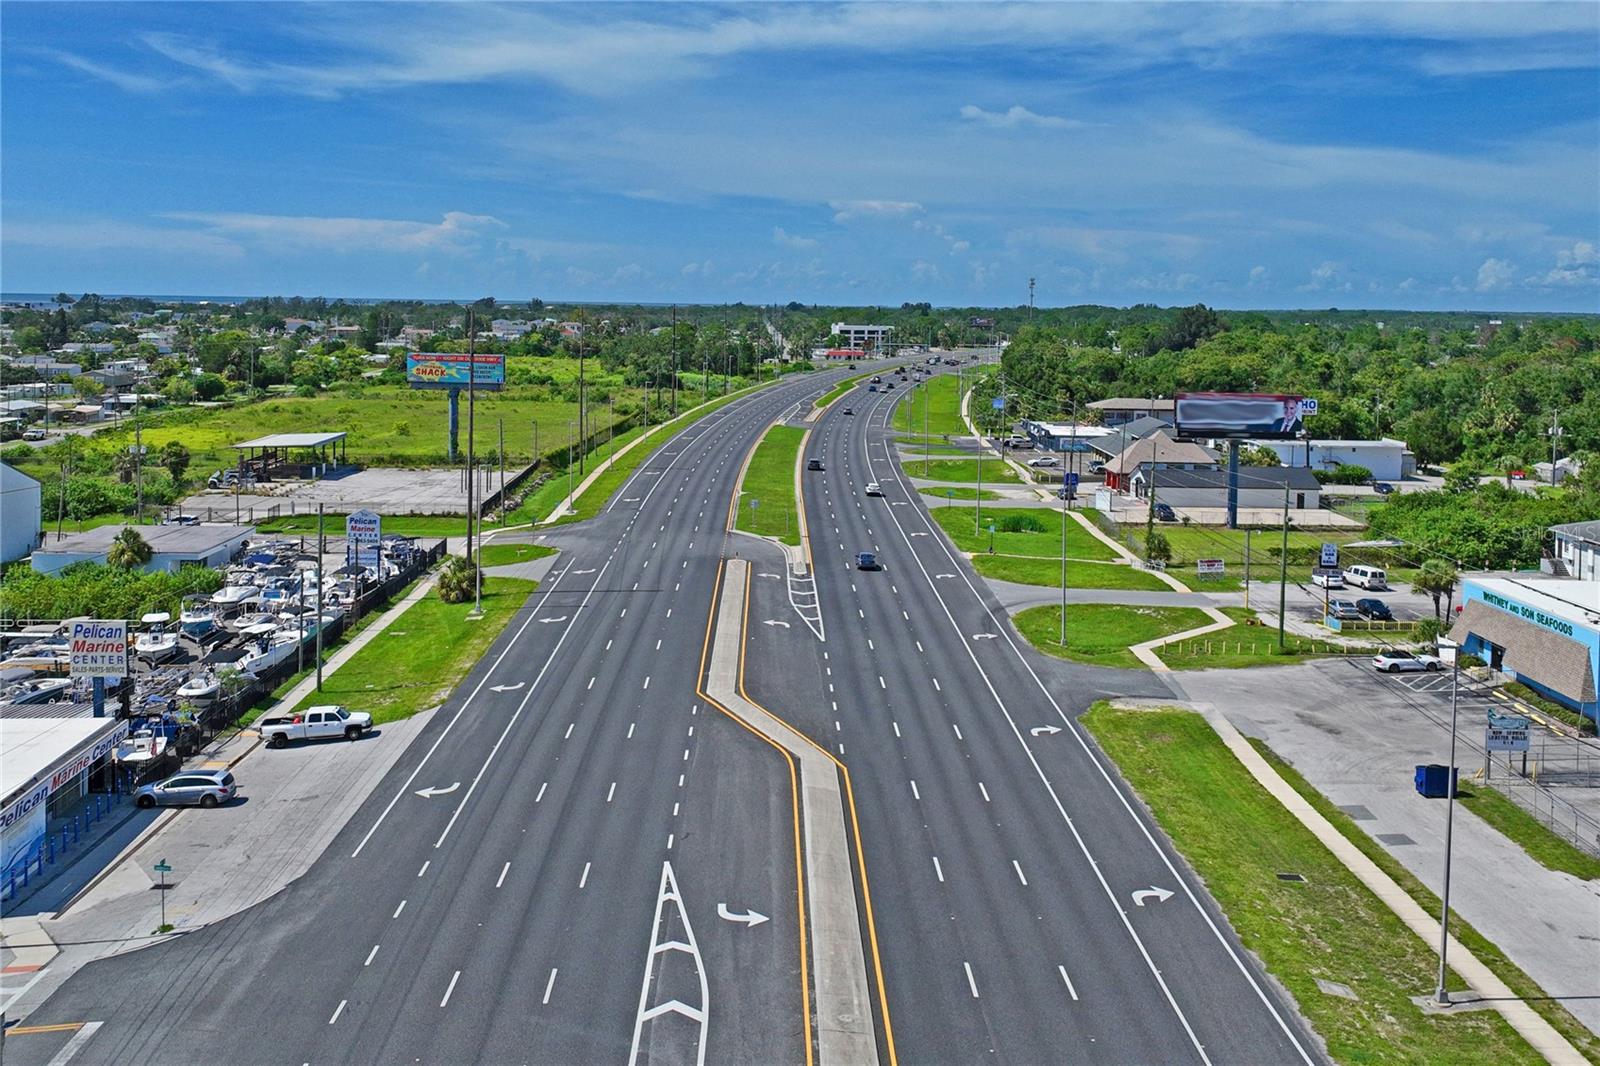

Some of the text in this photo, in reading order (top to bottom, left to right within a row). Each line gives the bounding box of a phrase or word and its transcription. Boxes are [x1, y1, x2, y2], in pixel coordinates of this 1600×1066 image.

[415, 367, 446, 377] SHACK
[349, 517, 377, 525] Pelican
[1482, 590, 1573, 636] WHITNEY AND SON SEAFOODS
[73, 623, 123, 639] Pelican
[72, 640, 125, 653] Marine
[72, 654, 125, 665] CENTER
[0, 727, 128, 827] Pelican Marine Center
